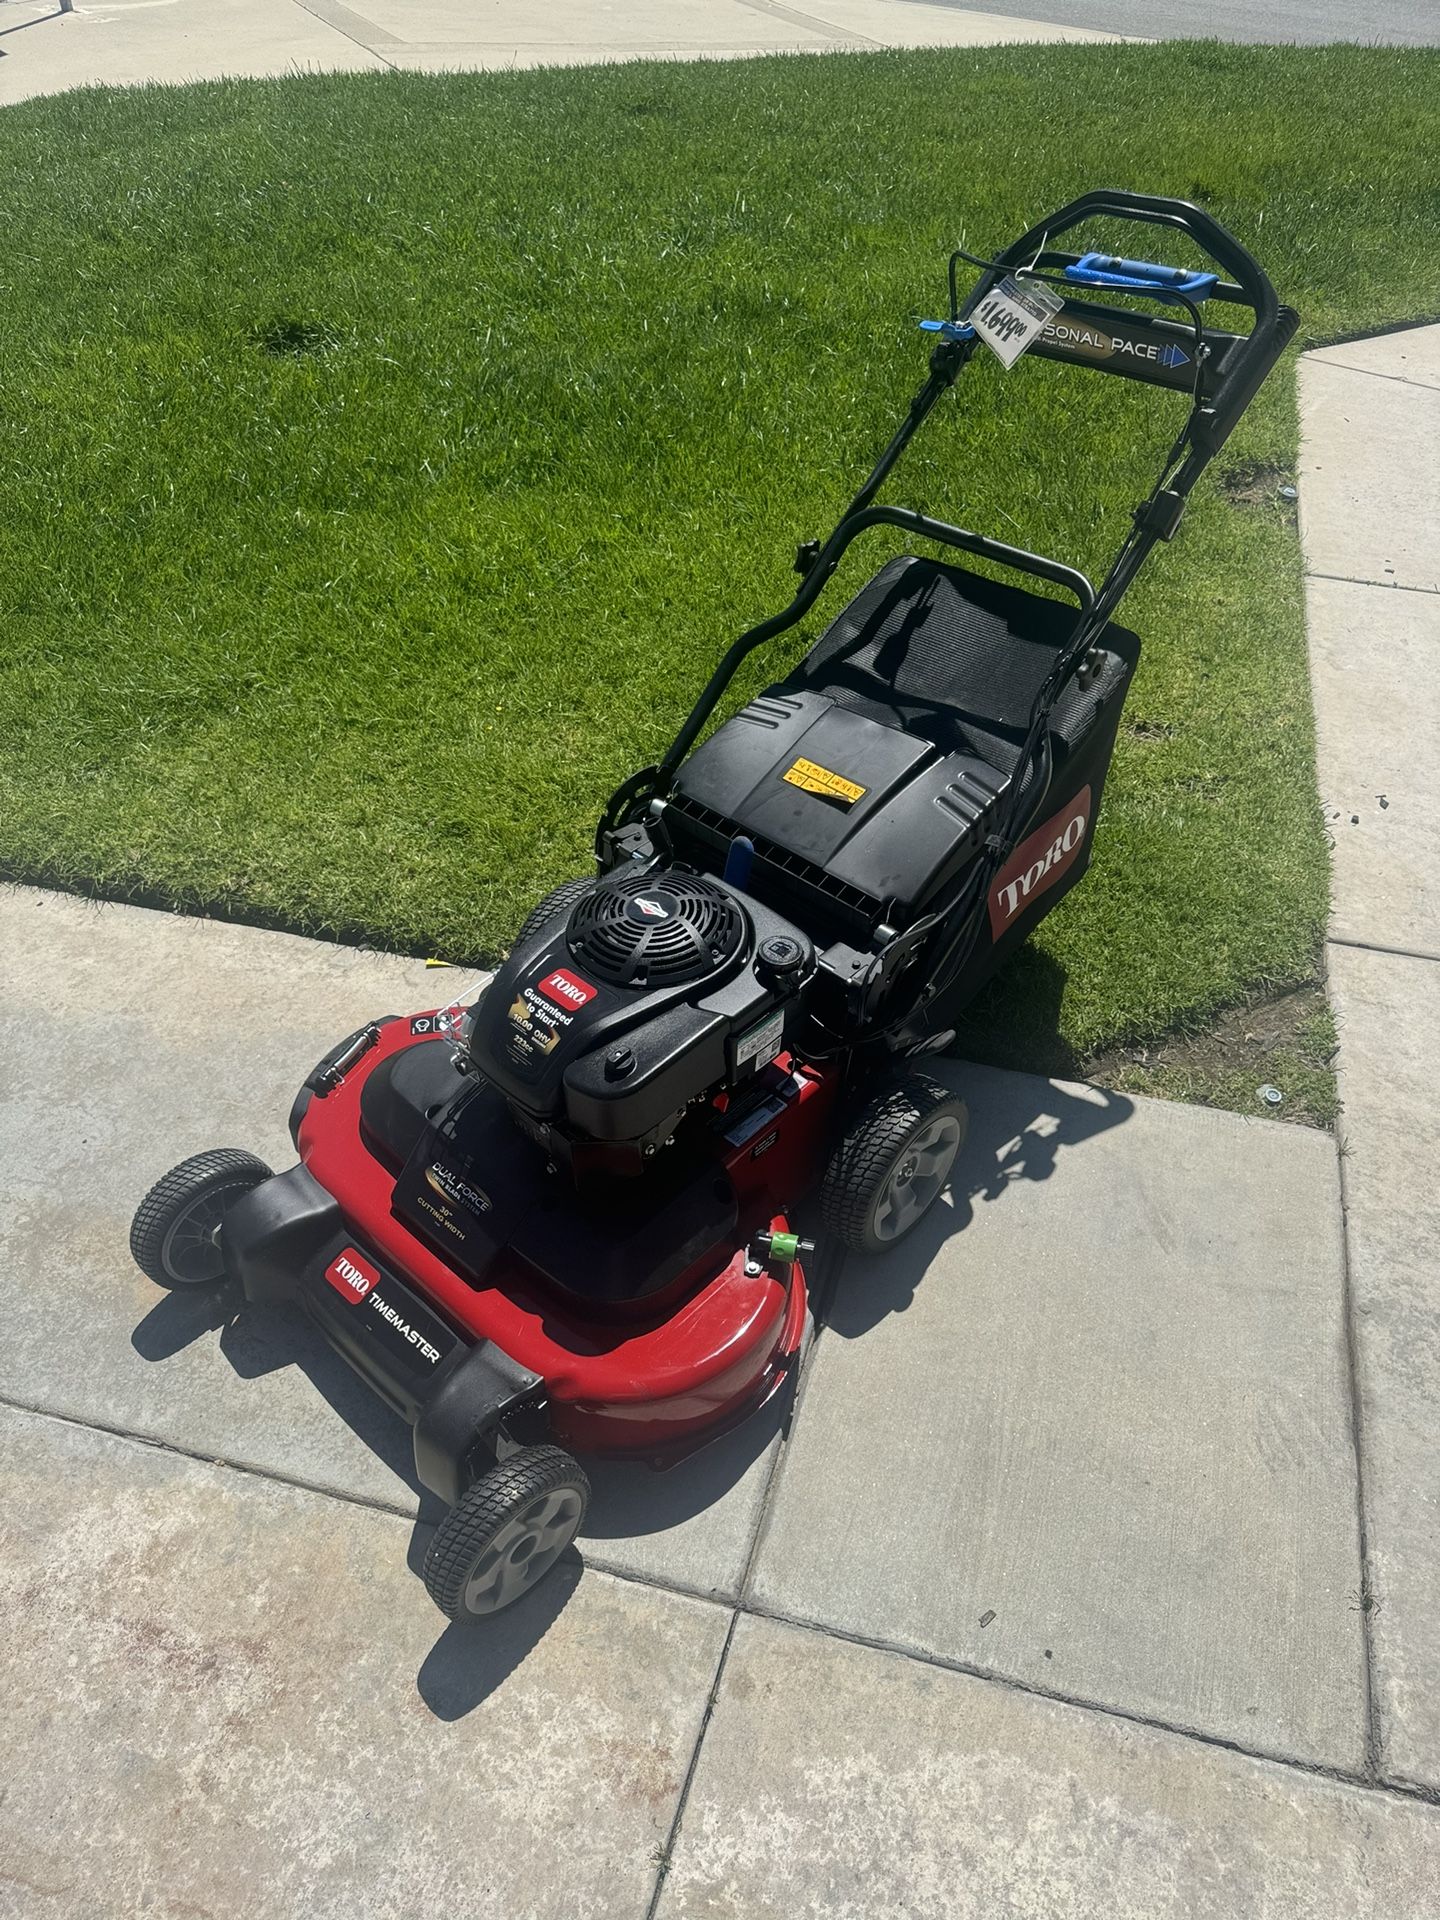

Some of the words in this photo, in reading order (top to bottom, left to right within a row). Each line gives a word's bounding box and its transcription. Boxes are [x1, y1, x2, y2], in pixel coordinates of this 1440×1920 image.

[1041, 323, 1104, 348] SONAL
[1111, 337, 1159, 360] PACE
[997, 815, 1086, 918] TORO
[524, 988, 574, 1026] Guaranteed
[549, 974, 587, 1003] TORO
[526, 1002, 536, 1013] to
[513, 1013, 533, 1031] 10.00
[534, 1029, 551, 1044] OHV
[513, 1034, 534, 1053] 223cc
[432, 1172, 445, 1186] TWIN
[432, 1161, 456, 1185] DUAL
[456, 1182, 490, 1211] FORCE
[417, 1197, 444, 1222] CUTTING
[444, 1219, 466, 1240] WIDTH
[334, 1257, 370, 1293] TORO
[368, 1292, 441, 1364] TIMEMASTER
